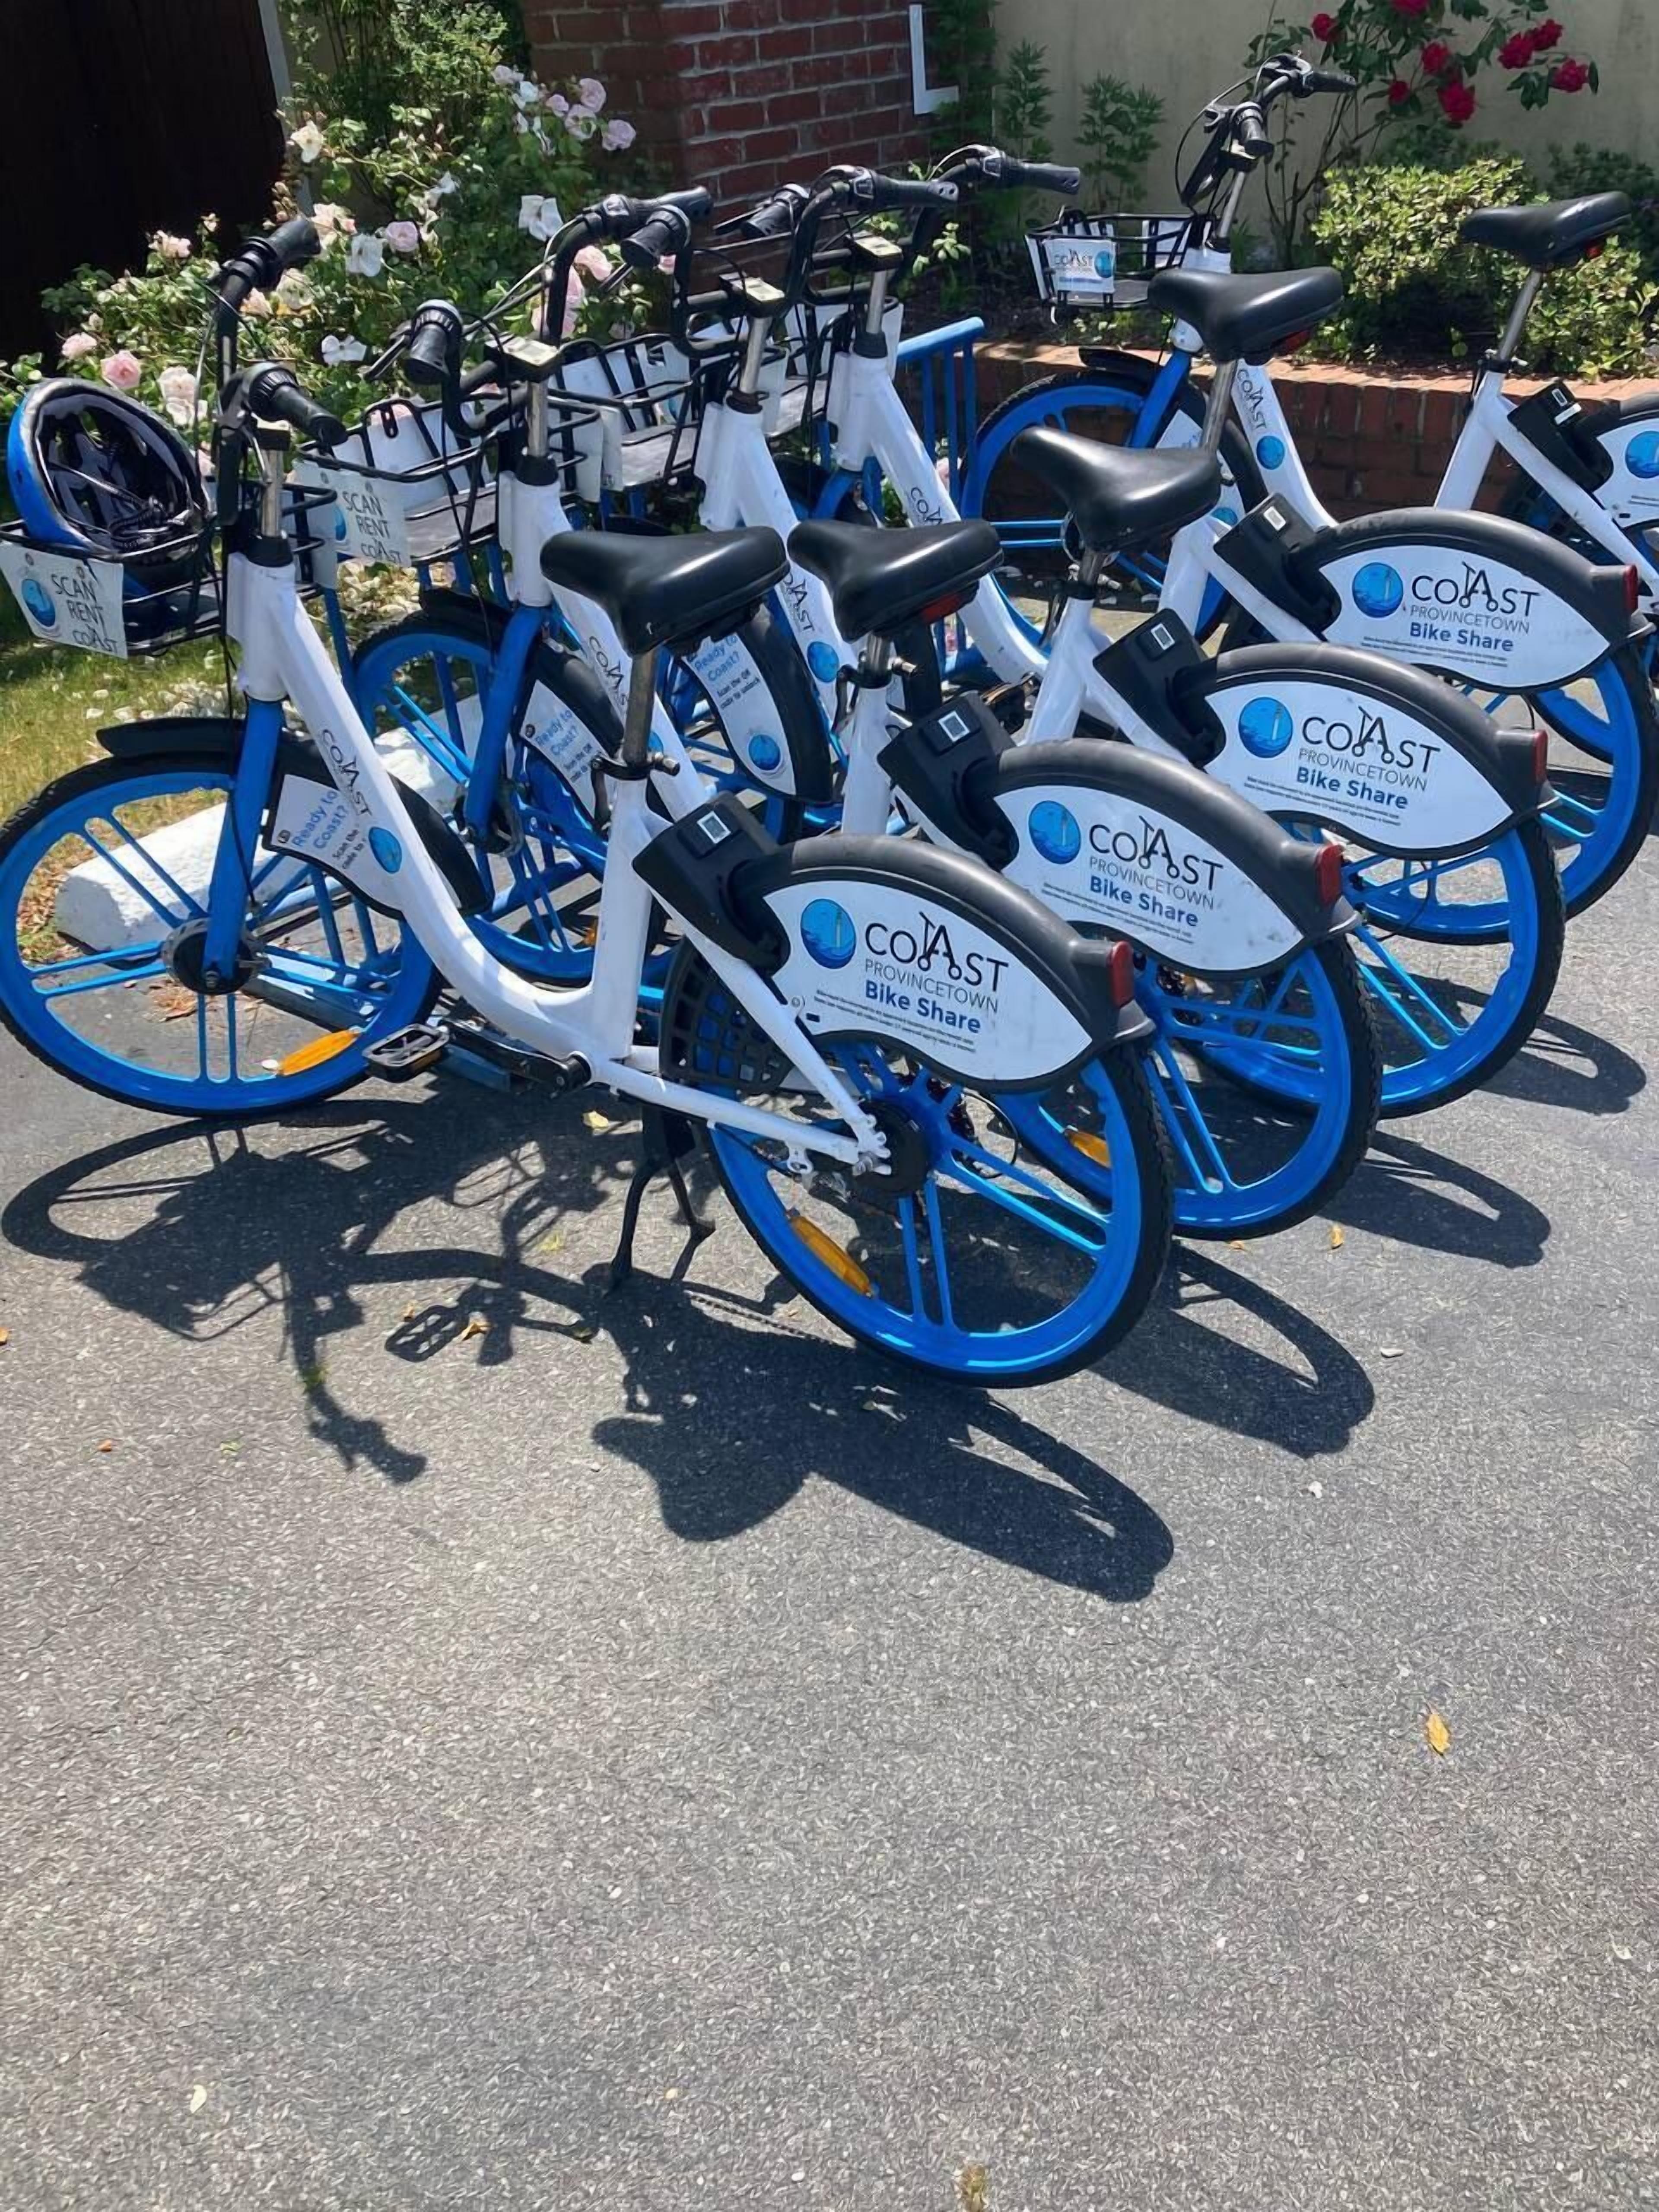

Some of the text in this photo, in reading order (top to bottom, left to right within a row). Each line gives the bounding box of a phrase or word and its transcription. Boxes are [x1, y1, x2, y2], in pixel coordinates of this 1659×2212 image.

[1238, 368, 1267, 429] COAST
[343, 491, 383, 515] SCAN
[356, 516, 391, 538] RENT
[361, 539, 401, 563] COAST
[51, 573, 97, 603] SCAN
[1411, 562, 1540, 617] COAST
[67, 600, 103, 628] RENT
[1410, 605, 1529, 635] PROVINCETOWN
[73, 624, 117, 653] COAST
[1410, 623, 1451, 642] Bike
[1457, 629, 1513, 652] Share
[1302, 706, 1440, 773] COAST
[322, 729, 372, 816] COAST
[1297, 766, 1340, 792] Bike
[1347, 780, 1408, 809] Share
[1298, 747, 1427, 792] PROVINCETOWN
[292, 806, 327, 847] Ready
[1089, 816, 1224, 891] COAST
[1089, 857, 1214, 910] PROVINCETOWN
[1090, 875, 1132, 904] Bike
[1139, 893, 1198, 927] Share
[864, 911, 1009, 991] COAST
[865, 958, 998, 1013] PROVINCETOWN
[866, 980, 910, 1010] Bike
[917, 997, 981, 1033] Share
